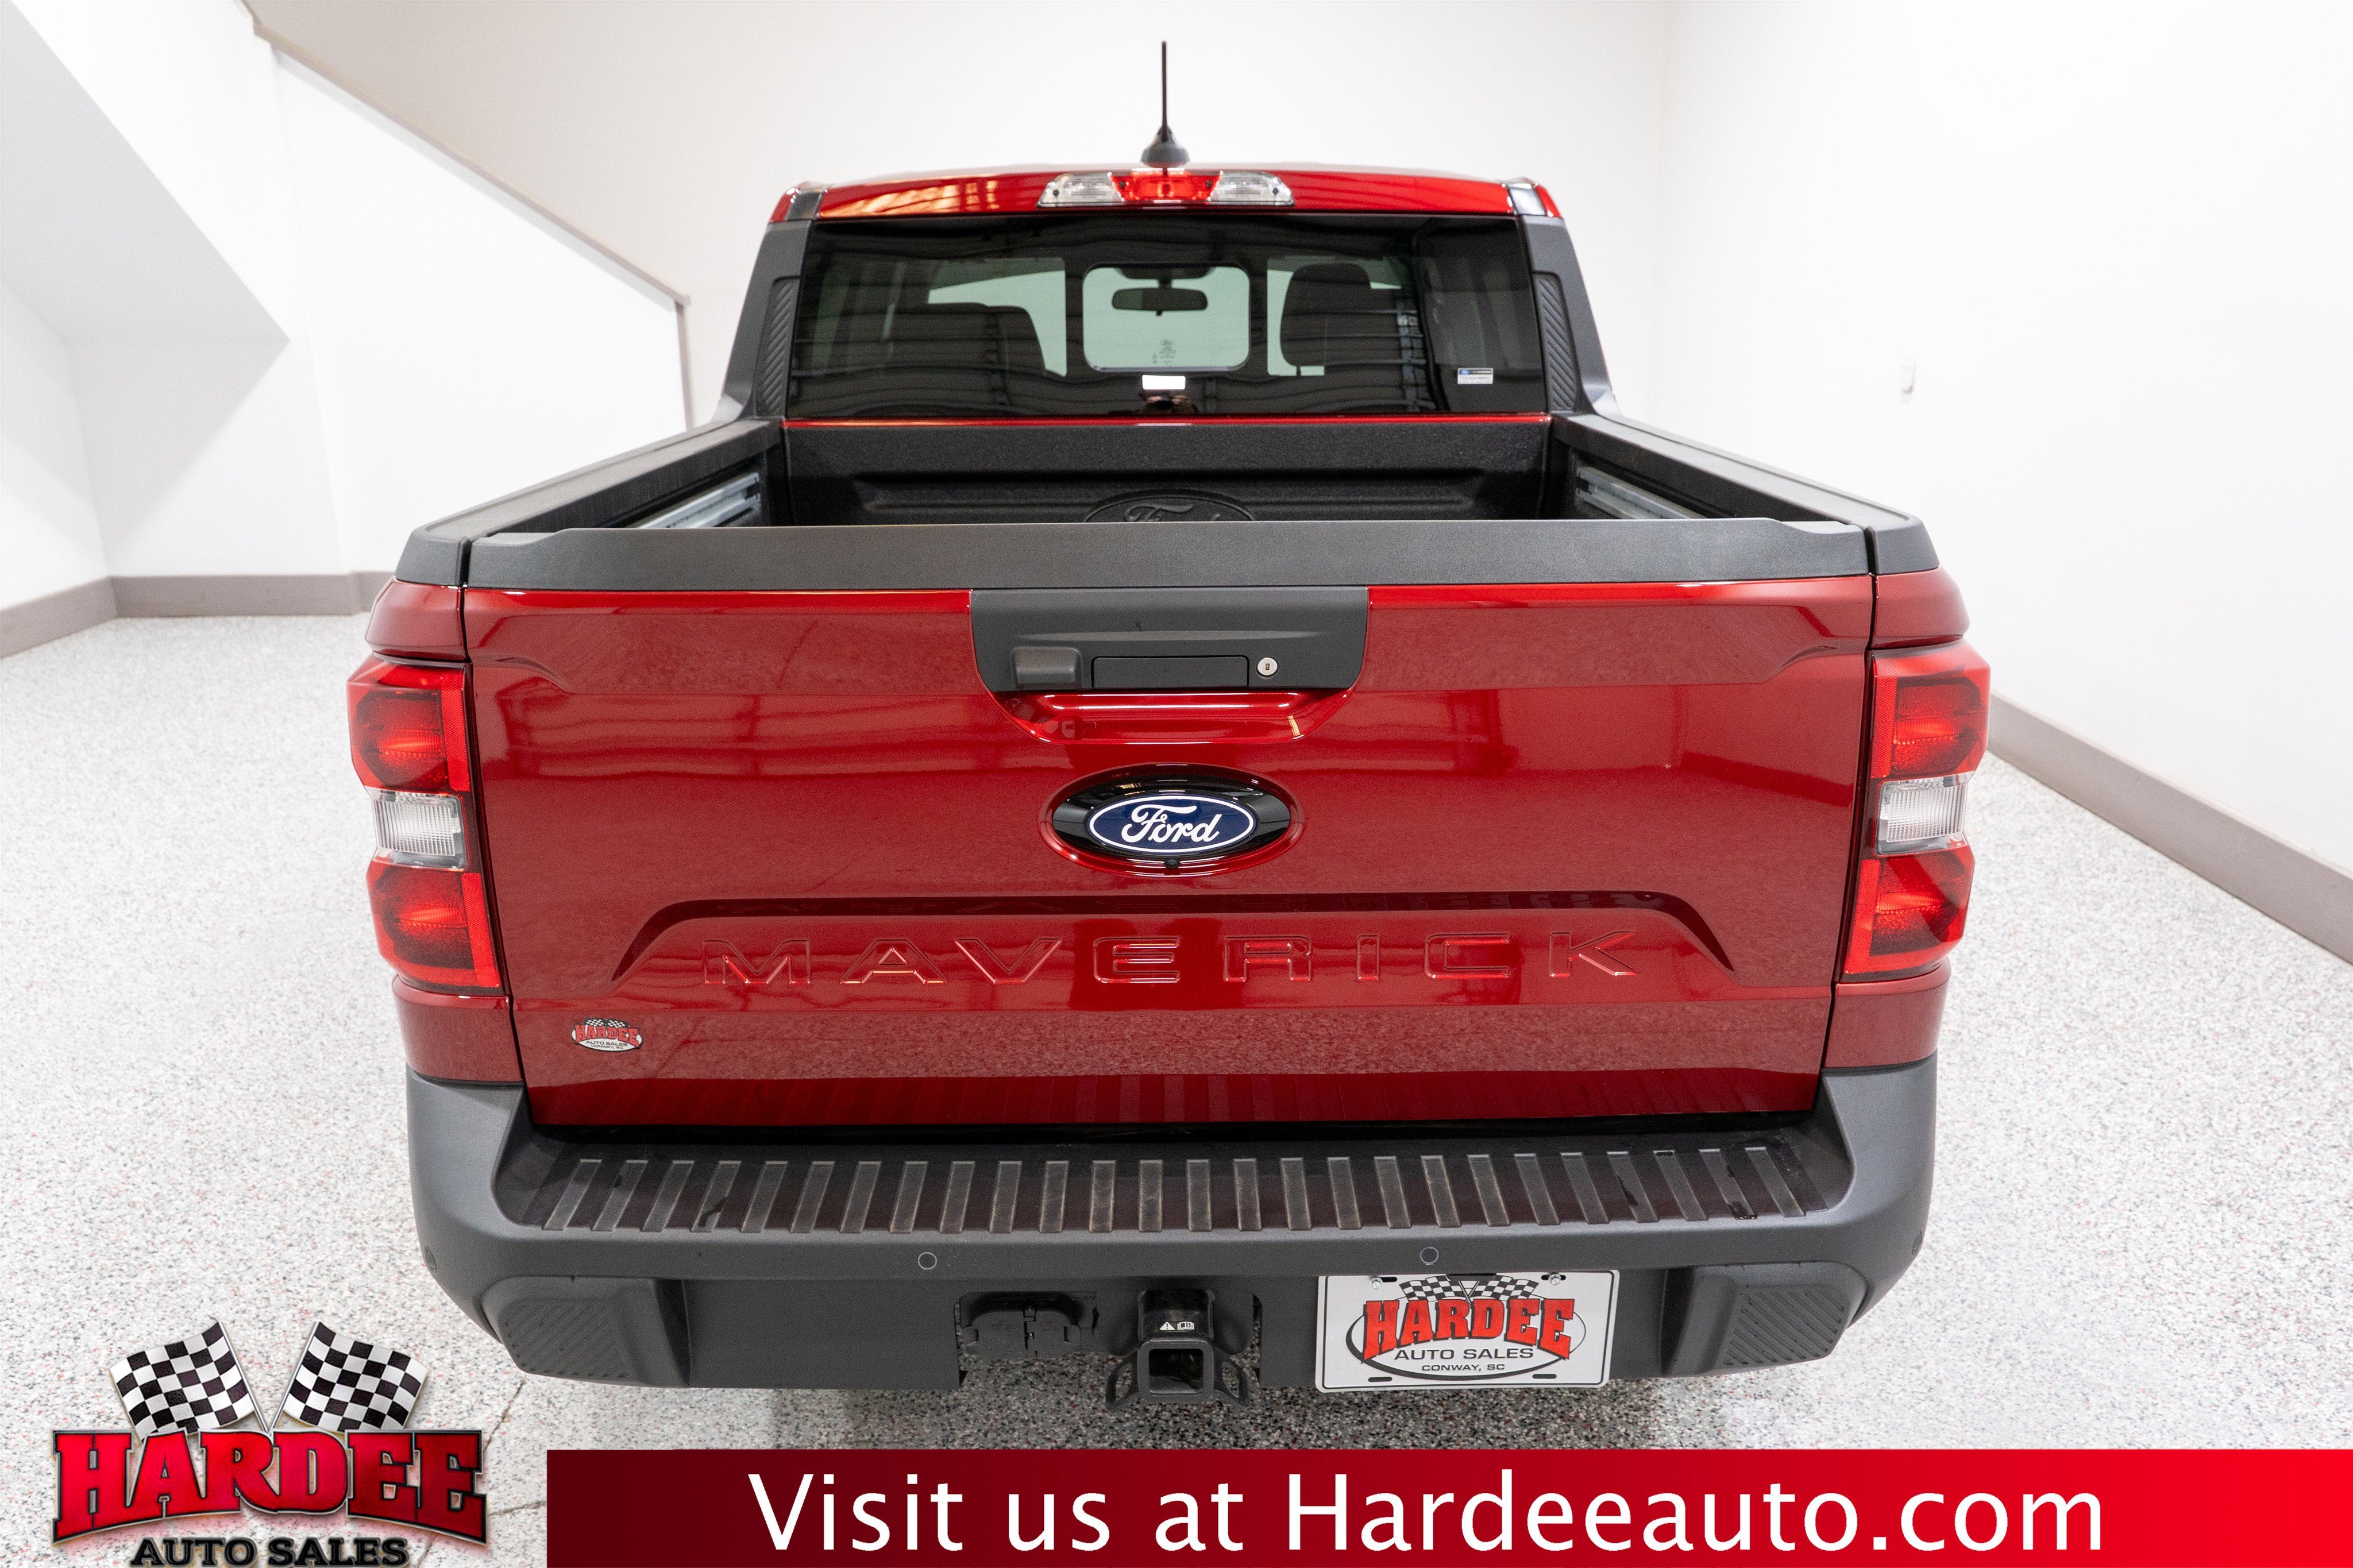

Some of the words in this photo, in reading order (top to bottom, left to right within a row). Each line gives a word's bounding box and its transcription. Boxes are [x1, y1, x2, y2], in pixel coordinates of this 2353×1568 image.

[1121, 804, 1223, 843] Ford
[703, 930, 1637, 985] MAVERICK
[574, 1024, 639, 1047] HARDEE
[1362, 1298, 1575, 1361] HARDEE
[1394, 1349, 1455, 1361] AUTO
[1463, 1347, 1534, 1360] SALES
[1421, 1364, 1482, 1372] CONWAY,
[1487, 1363, 1506, 1371] SC
